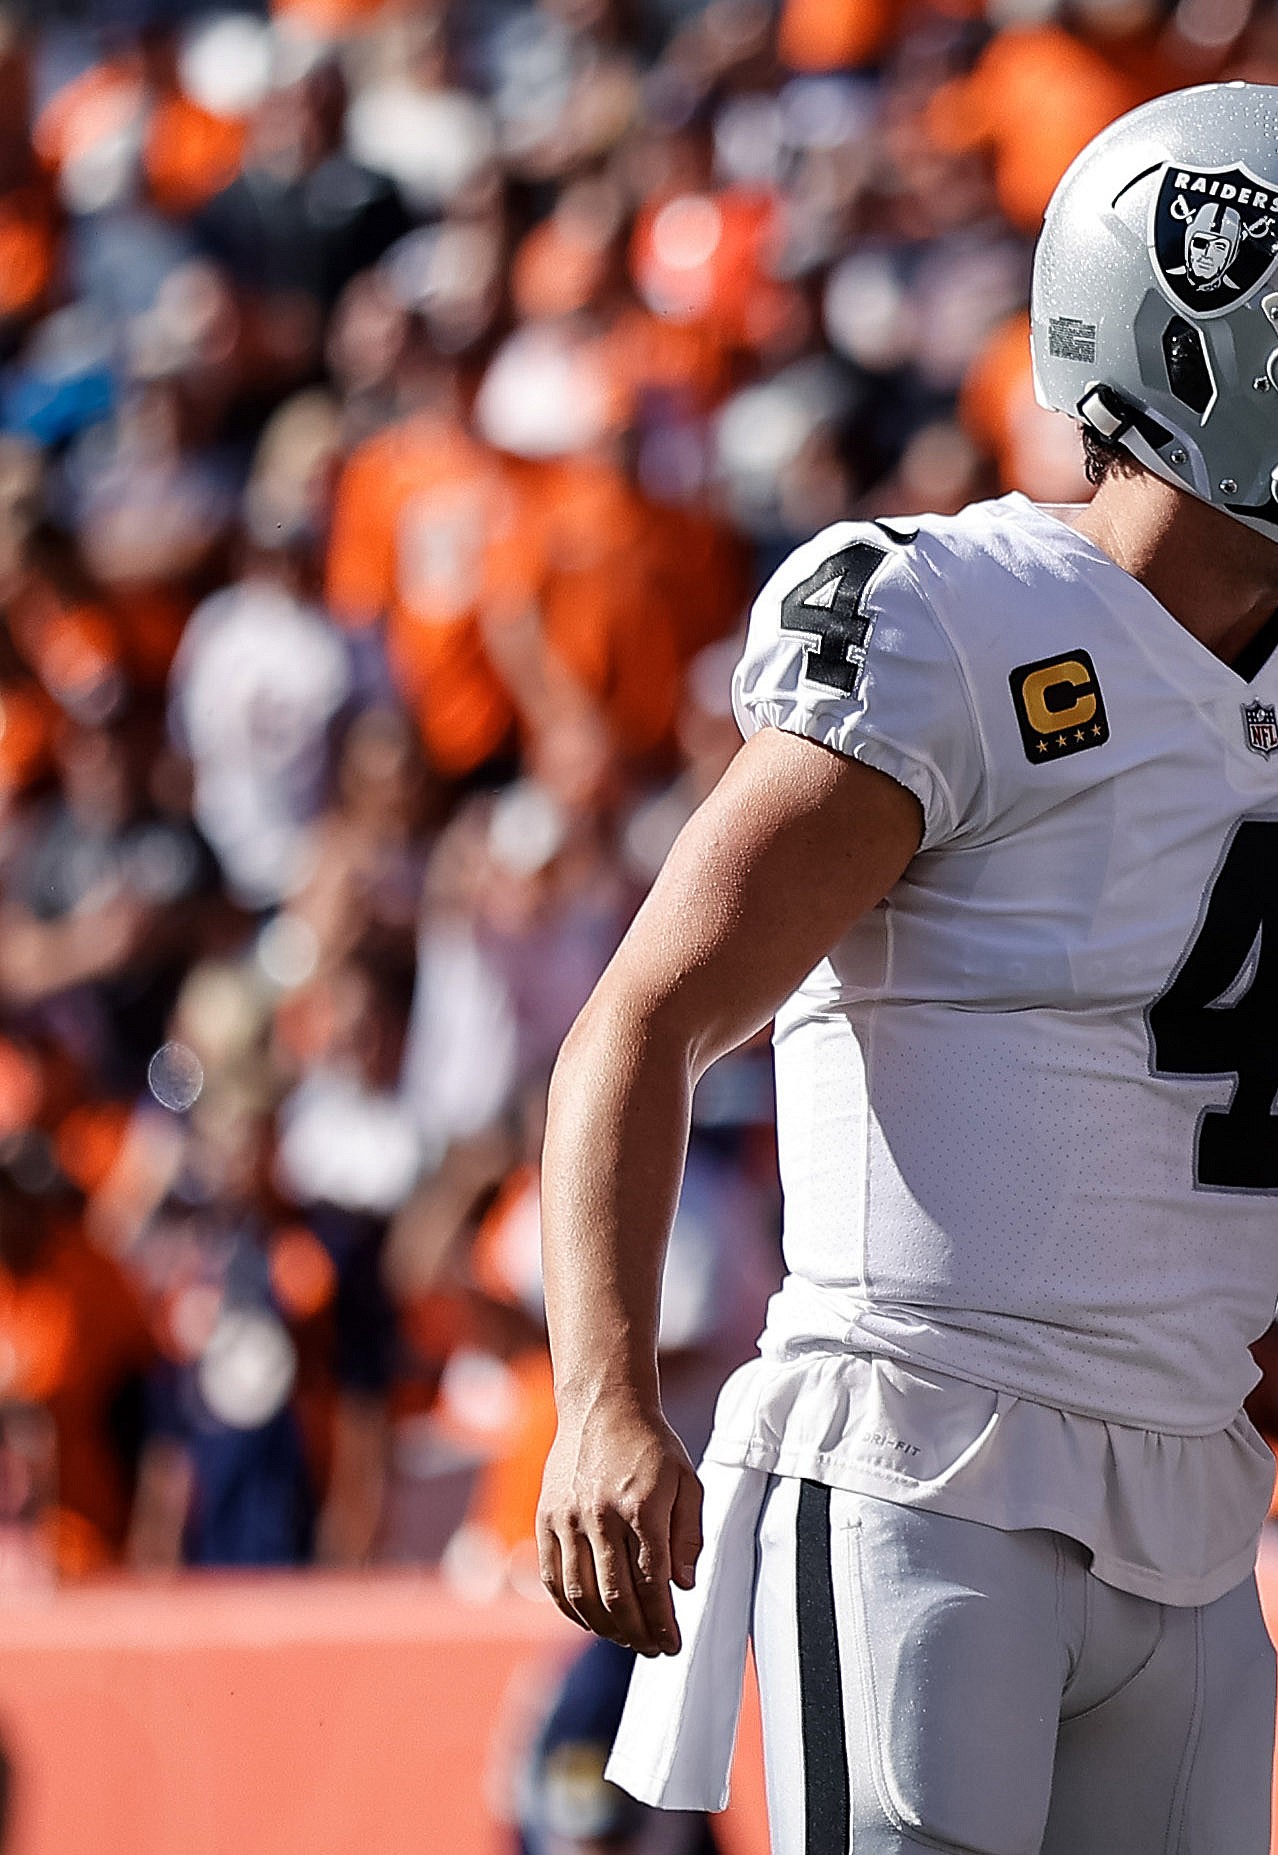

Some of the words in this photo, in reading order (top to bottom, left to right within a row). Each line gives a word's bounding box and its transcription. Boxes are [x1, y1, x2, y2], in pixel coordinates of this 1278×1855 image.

[780, 542, 889, 699] 4
[1021, 660, 1097, 734] C
[1250, 725, 1278, 749] NFL
